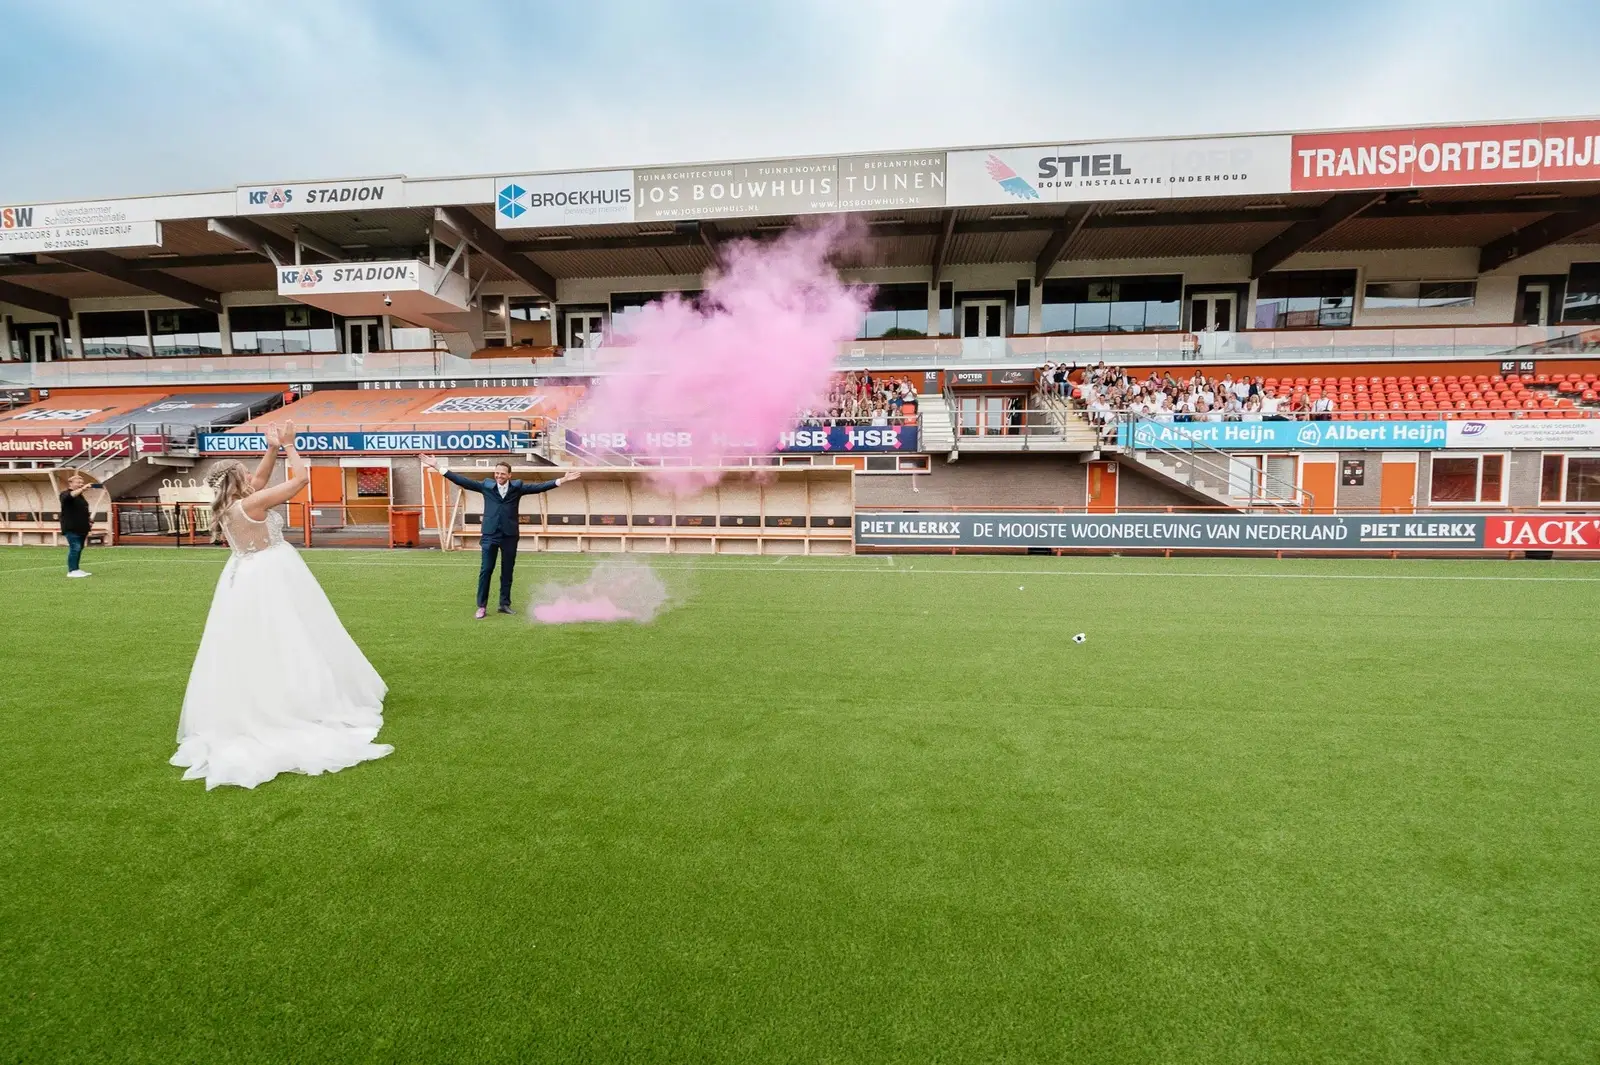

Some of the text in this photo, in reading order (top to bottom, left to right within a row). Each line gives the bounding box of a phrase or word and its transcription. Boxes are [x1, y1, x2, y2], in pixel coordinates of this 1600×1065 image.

[1299, 135, 1600, 177] TRANSPORTBEDRIJ
[638, 158, 941, 181] TUINARCHITECTUUR TUINRENOVATIE BEPLANTINGEN
[1038, 154, 1131, 179] STIEL
[1080, 177, 1162, 187] INSTALLATIE
[1170, 173, 1248, 183] ONDERHOUD
[306, 186, 384, 203] STADION
[531, 188, 631, 207] BROEKHUIS
[637, 172, 944, 207] JOS BOUWHUIS TUINEN
[0, 207, 33, 228] SW
[55, 206, 112, 217] Volendammer
[66, 225, 132, 236] AFBOUWBEDRIJF
[333, 266, 408, 282] STADION
[1502, 361, 1515, 370] KF
[1520, 361, 1533, 370] KG
[363, 379, 539, 389] HENK KRAS TRIBUNE
[206, 434, 523, 450] KEUKEN ODS.NL KEUKEN LOODS.NL
[582, 432, 627, 448] HSB
[646, 432, 692, 447] HSB
[781, 430, 828, 447] HSB
[849, 430, 898, 447] HSB
[1161, 427, 1218, 441] Albert
[1225, 425, 1275, 443] Heijn
[1325, 425, 1387, 440] Albert
[1394, 424, 1445, 443] Heijn
[861, 521, 1476, 540] PIET KLERKX DE MOOISTE WOONBELEVING VAN NEDERLAND PIET KLERKX
[1496, 520, 1600, 545] JACK'
